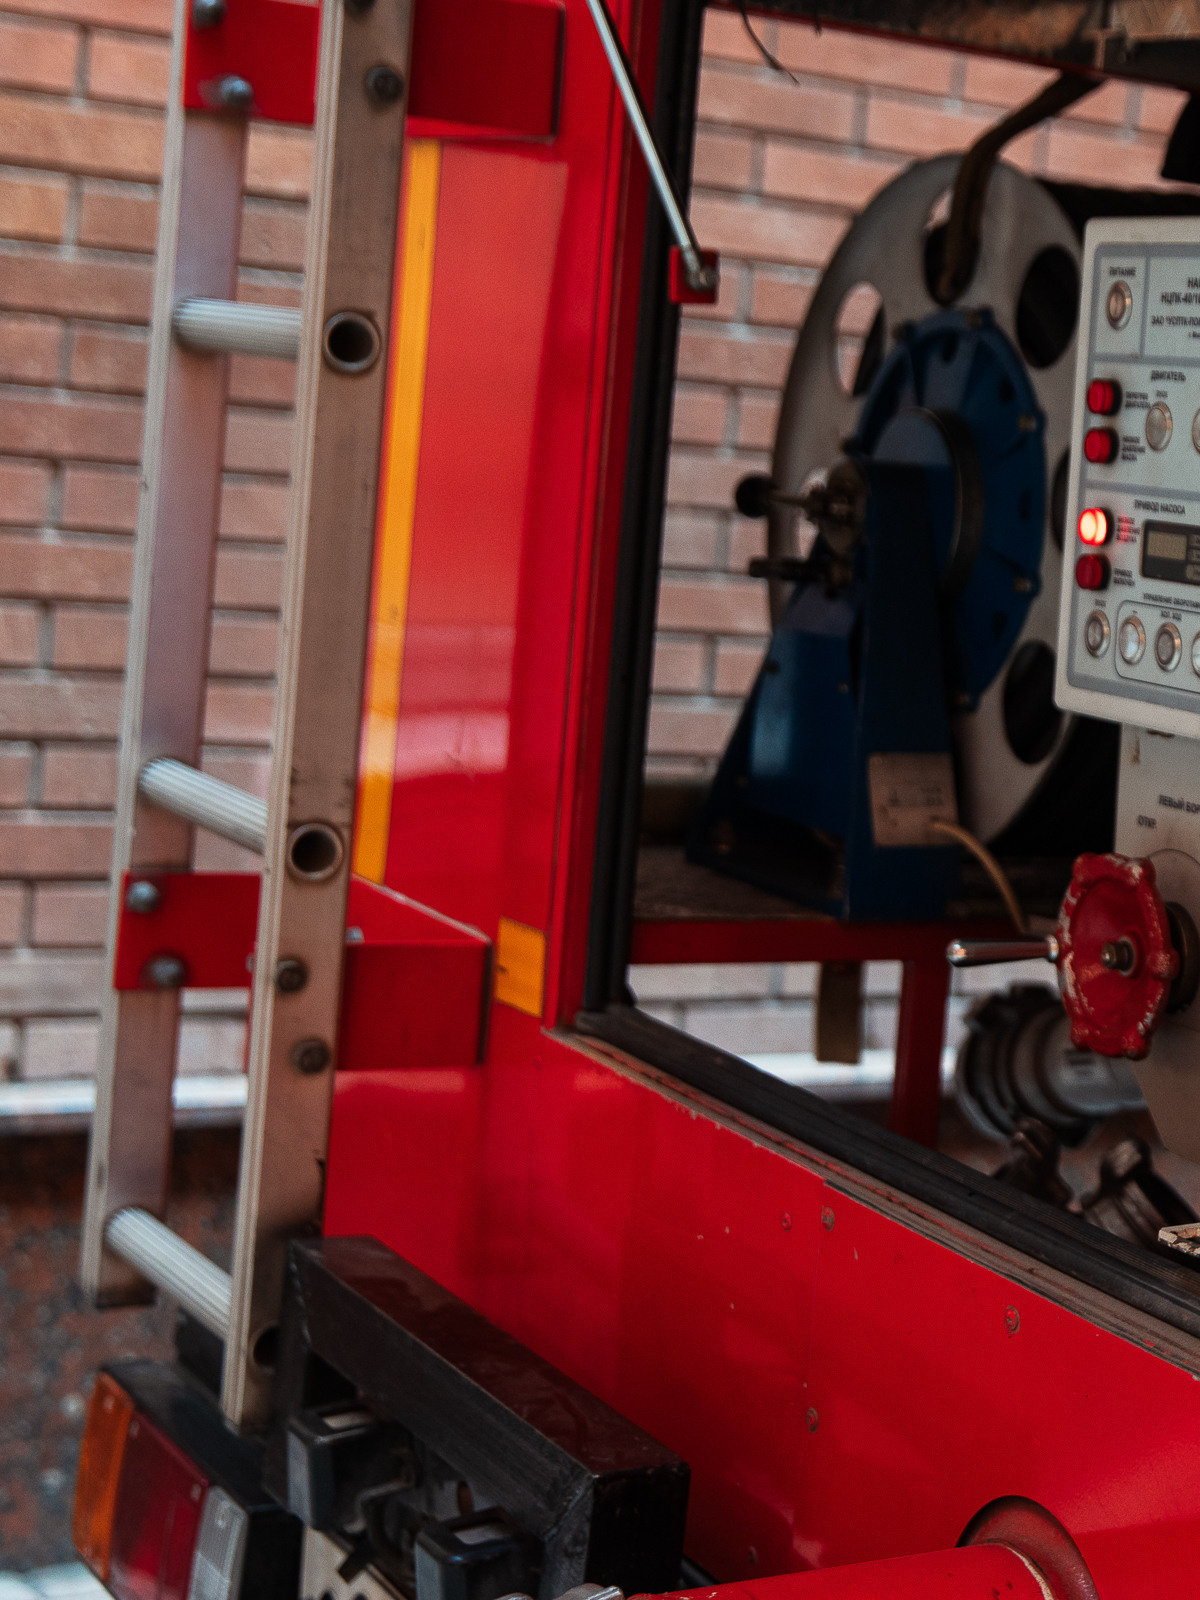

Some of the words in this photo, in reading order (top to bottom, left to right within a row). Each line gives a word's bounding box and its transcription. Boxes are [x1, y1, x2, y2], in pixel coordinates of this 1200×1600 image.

[1151, 370, 1186, 381] ДВИГАТЕЛЬ
[1134, 499, 1159, 513] ПРИВОД
[1160, 503, 1186, 515] НАСОСА
